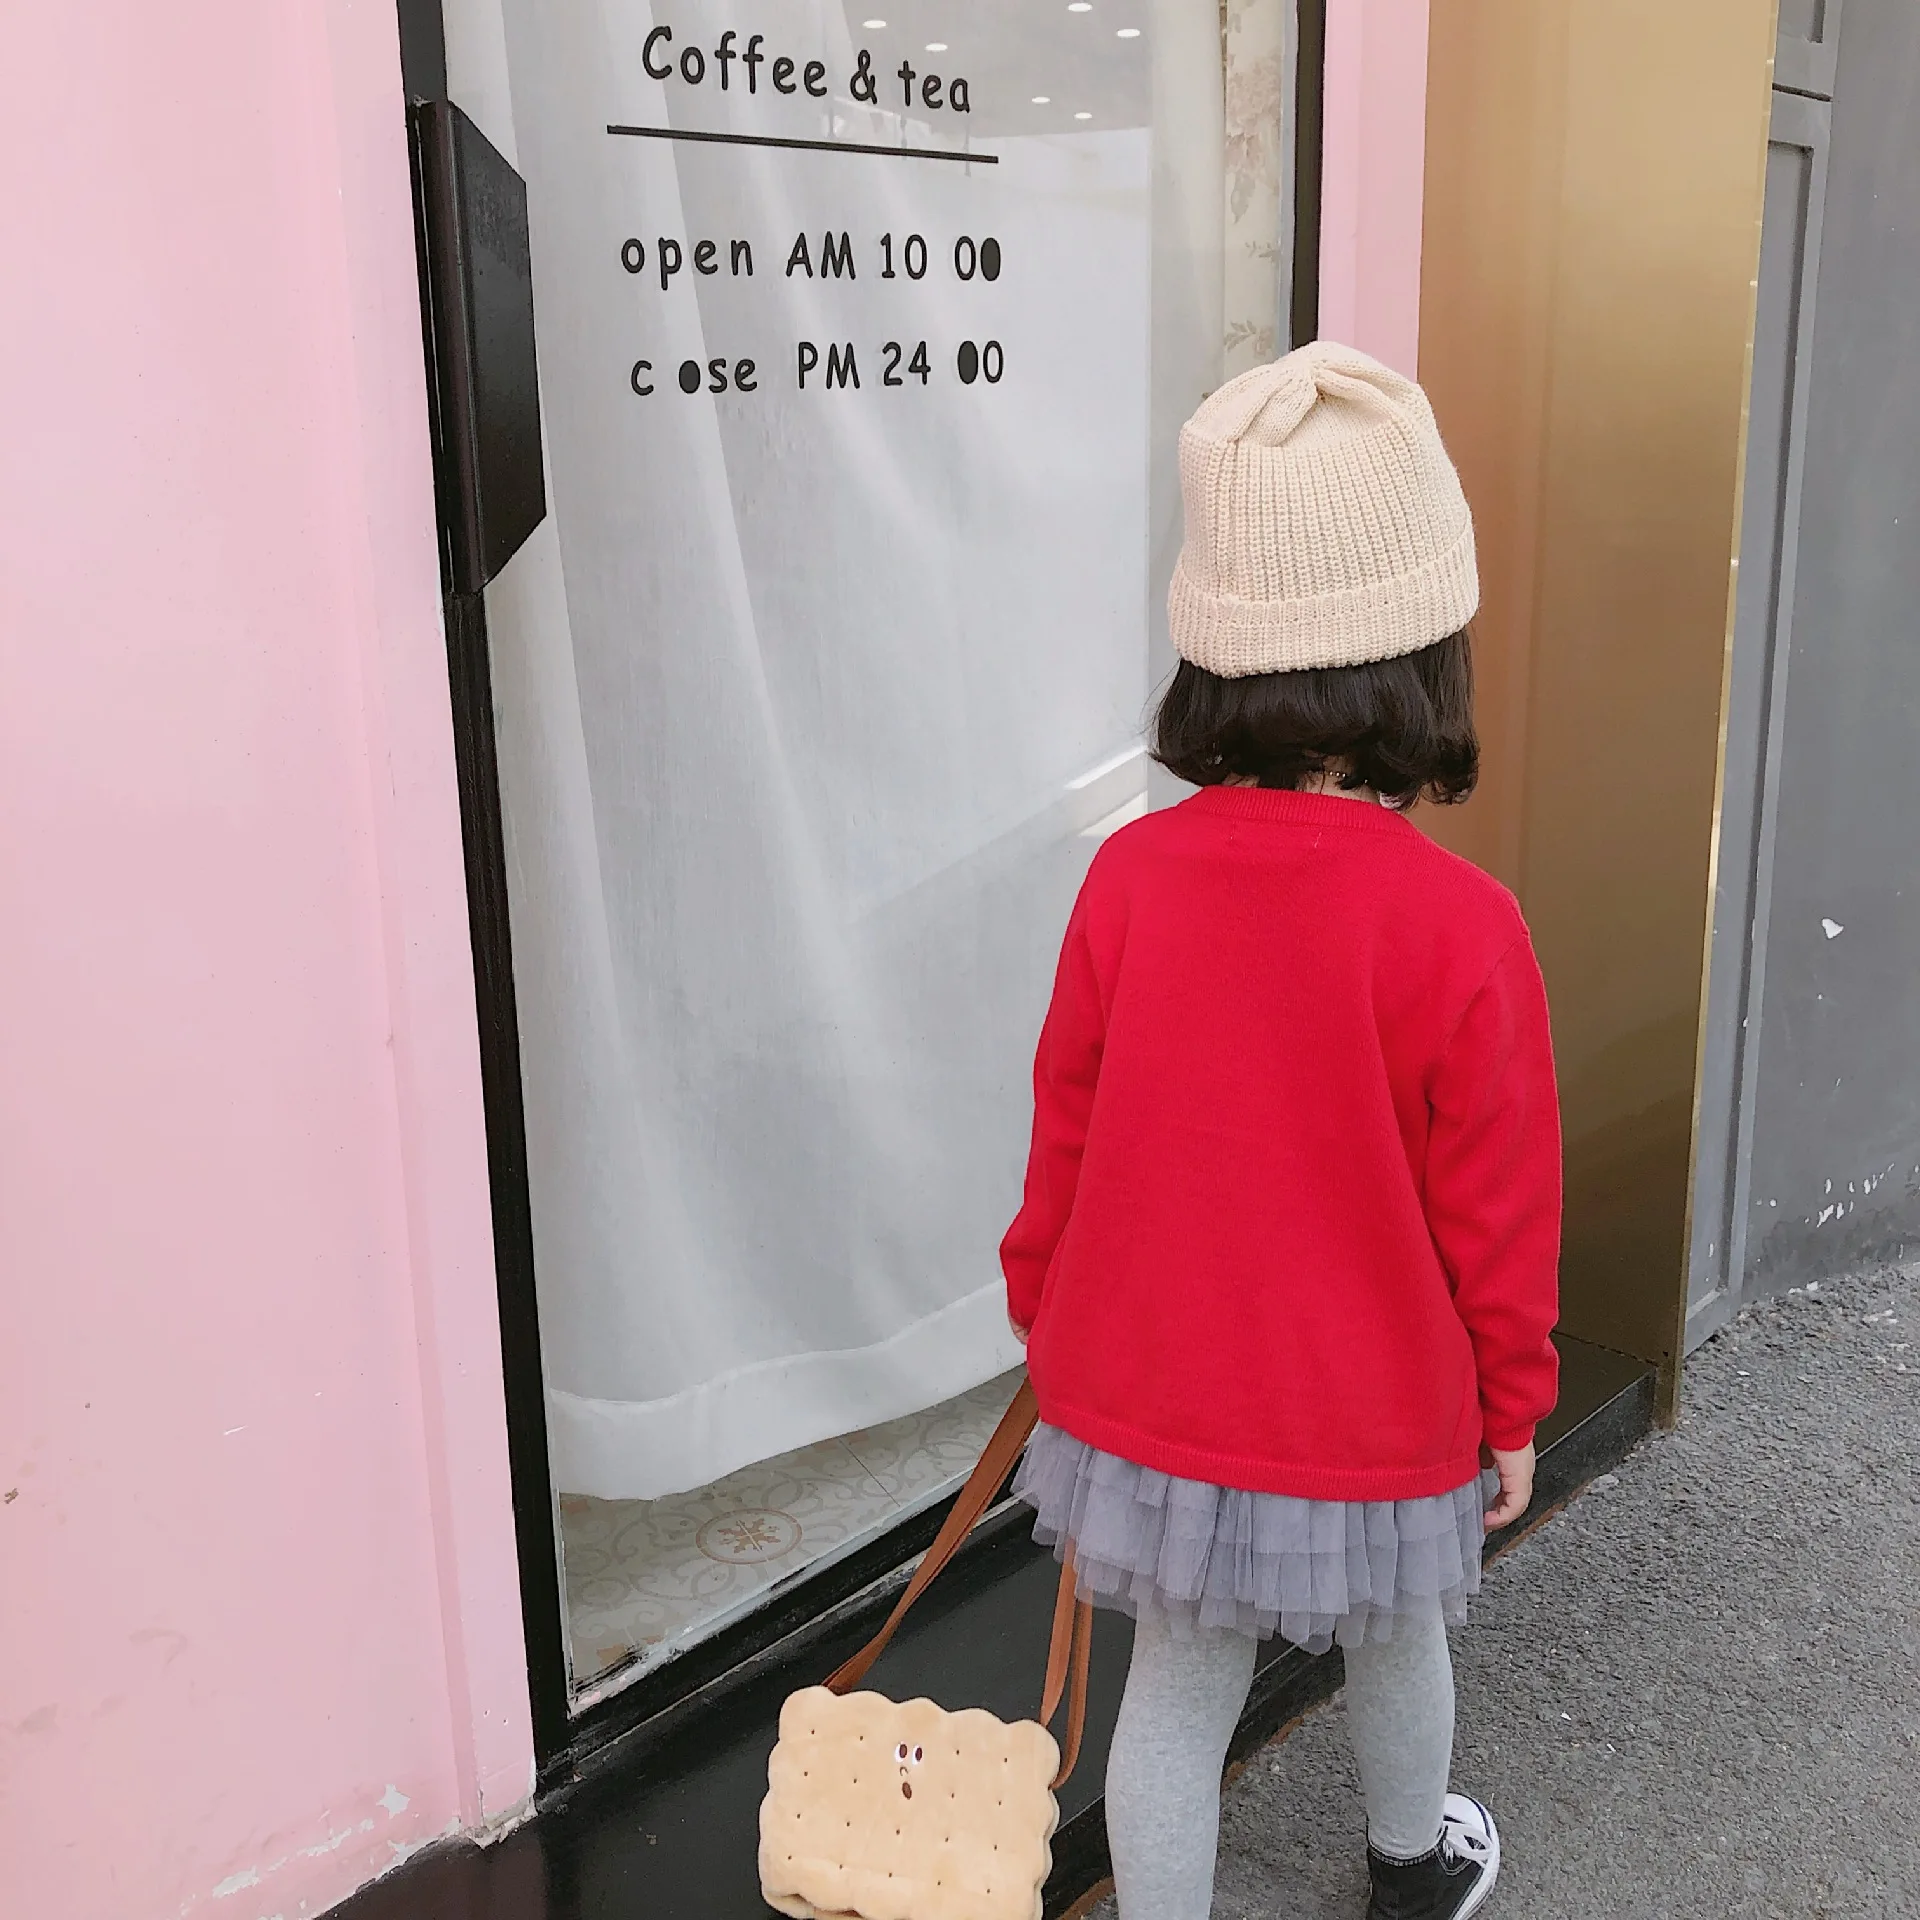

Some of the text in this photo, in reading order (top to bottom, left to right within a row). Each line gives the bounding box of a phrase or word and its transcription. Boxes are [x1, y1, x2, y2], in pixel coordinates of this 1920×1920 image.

[641, 25, 971, 114] Coffee & tea
[620, 231, 1002, 292] open AM 10 00
[797, 341, 861, 390] PM
[881, 340, 932, 387] 24
[956, 340, 1004, 386] 00
